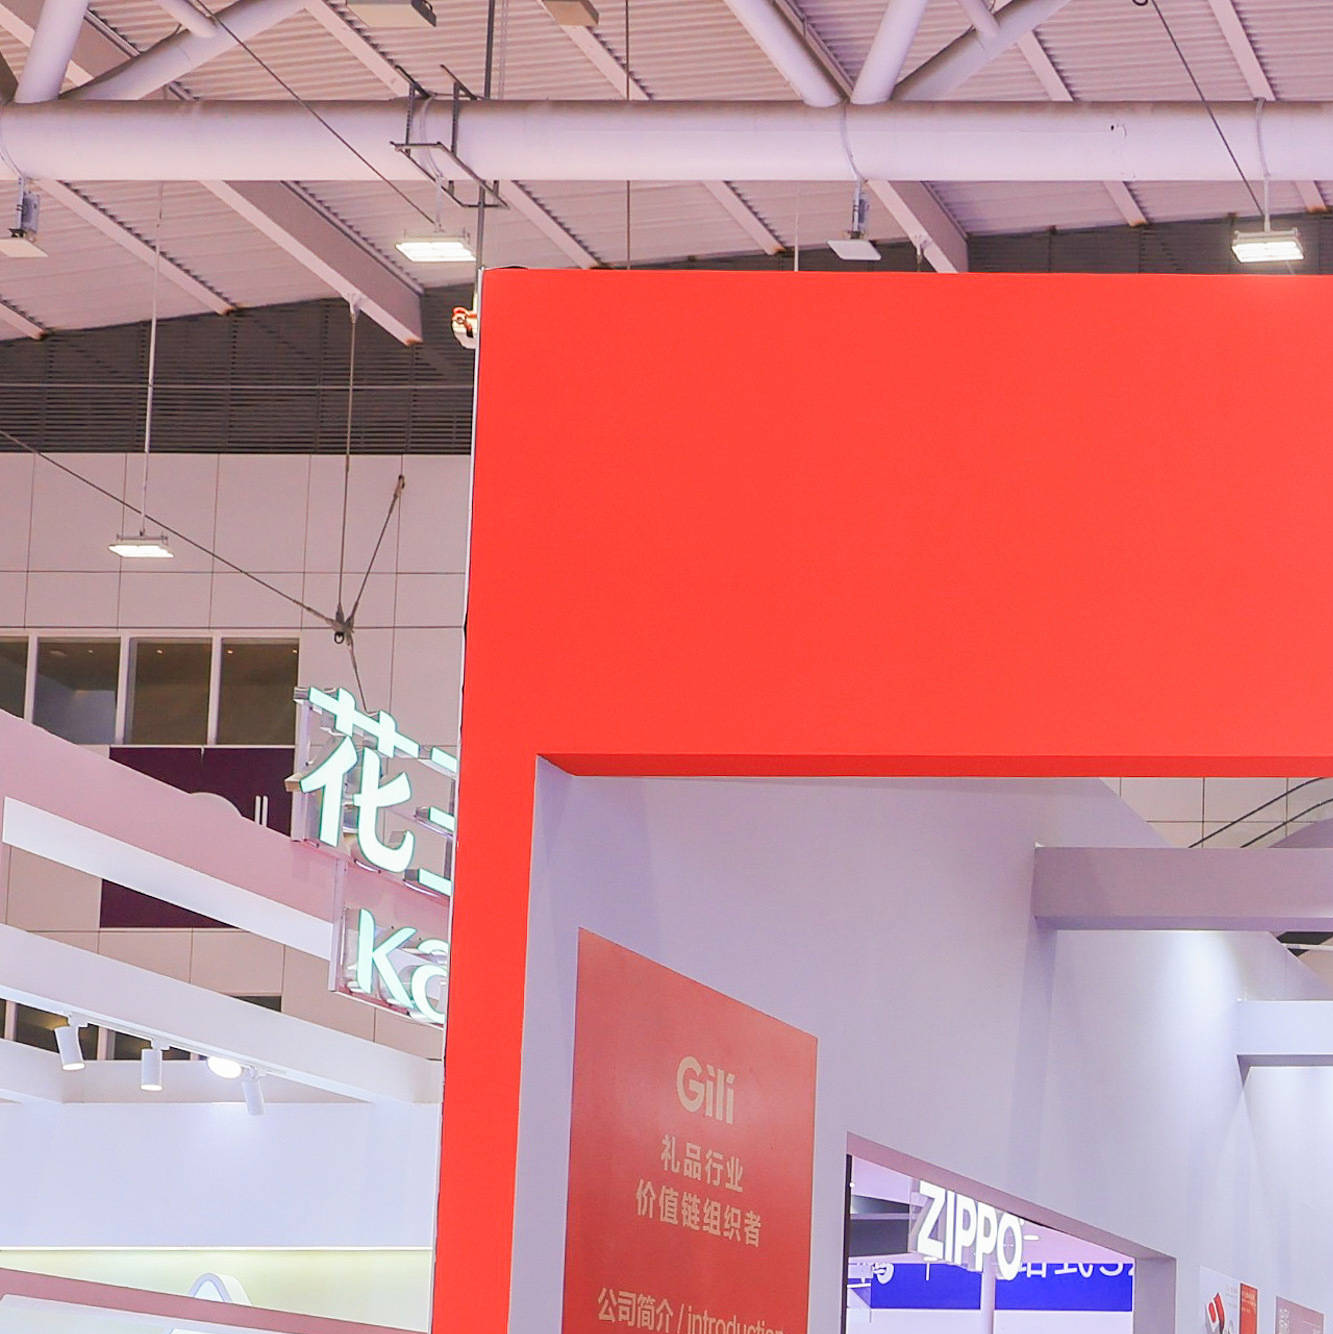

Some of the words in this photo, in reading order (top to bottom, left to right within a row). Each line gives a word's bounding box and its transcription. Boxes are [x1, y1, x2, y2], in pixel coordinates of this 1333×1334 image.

[676, 1056, 735, 1124] Gili
[661, 1134, 744, 1193] 礼品行业
[636, 1179, 762, 1248] 价值链组织者
[917, 1180, 1024, 1281] ZIPPO
